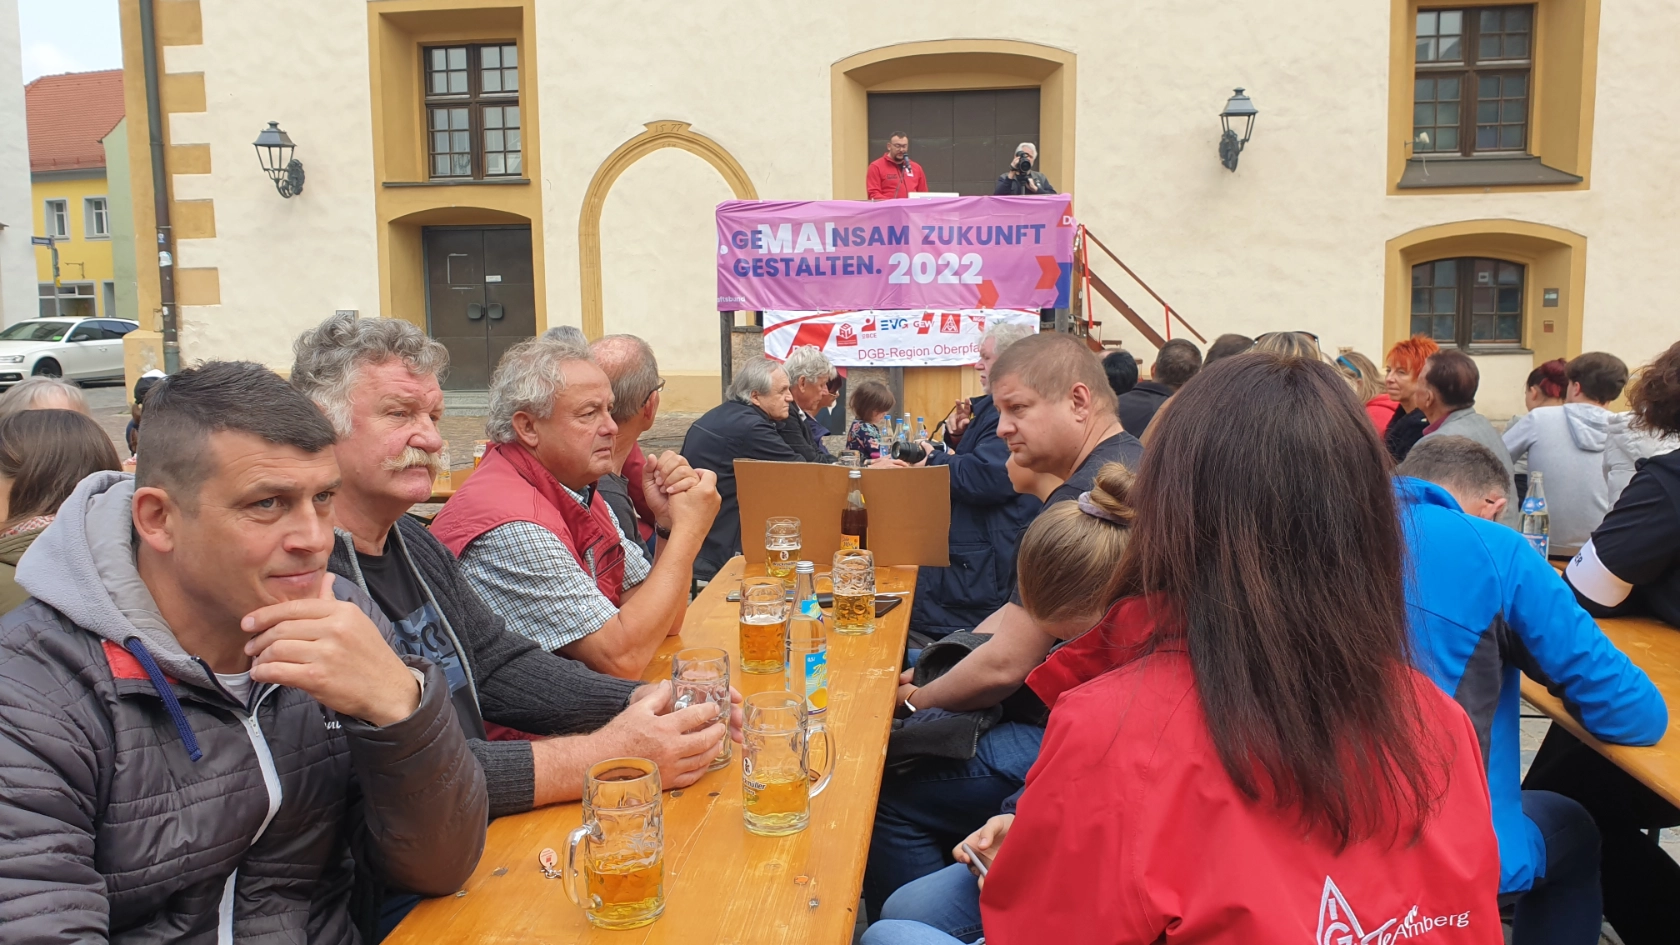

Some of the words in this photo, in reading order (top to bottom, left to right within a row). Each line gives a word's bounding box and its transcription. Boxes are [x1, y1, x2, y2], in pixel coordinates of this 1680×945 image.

[655, 123, 683, 133] 1577
[921, 223, 1046, 246] ZUKUNFT
[733, 254, 882, 278] GESTALTEN.
[888, 252, 984, 285] 2022
[880, 318, 909, 331] EVG
[913, 320, 935, 328] GEW
[858, 345, 930, 360] DGB-Region
[933, 342, 980, 358] Oberpfa
[1391, 910, 1471, 945] Amberg
